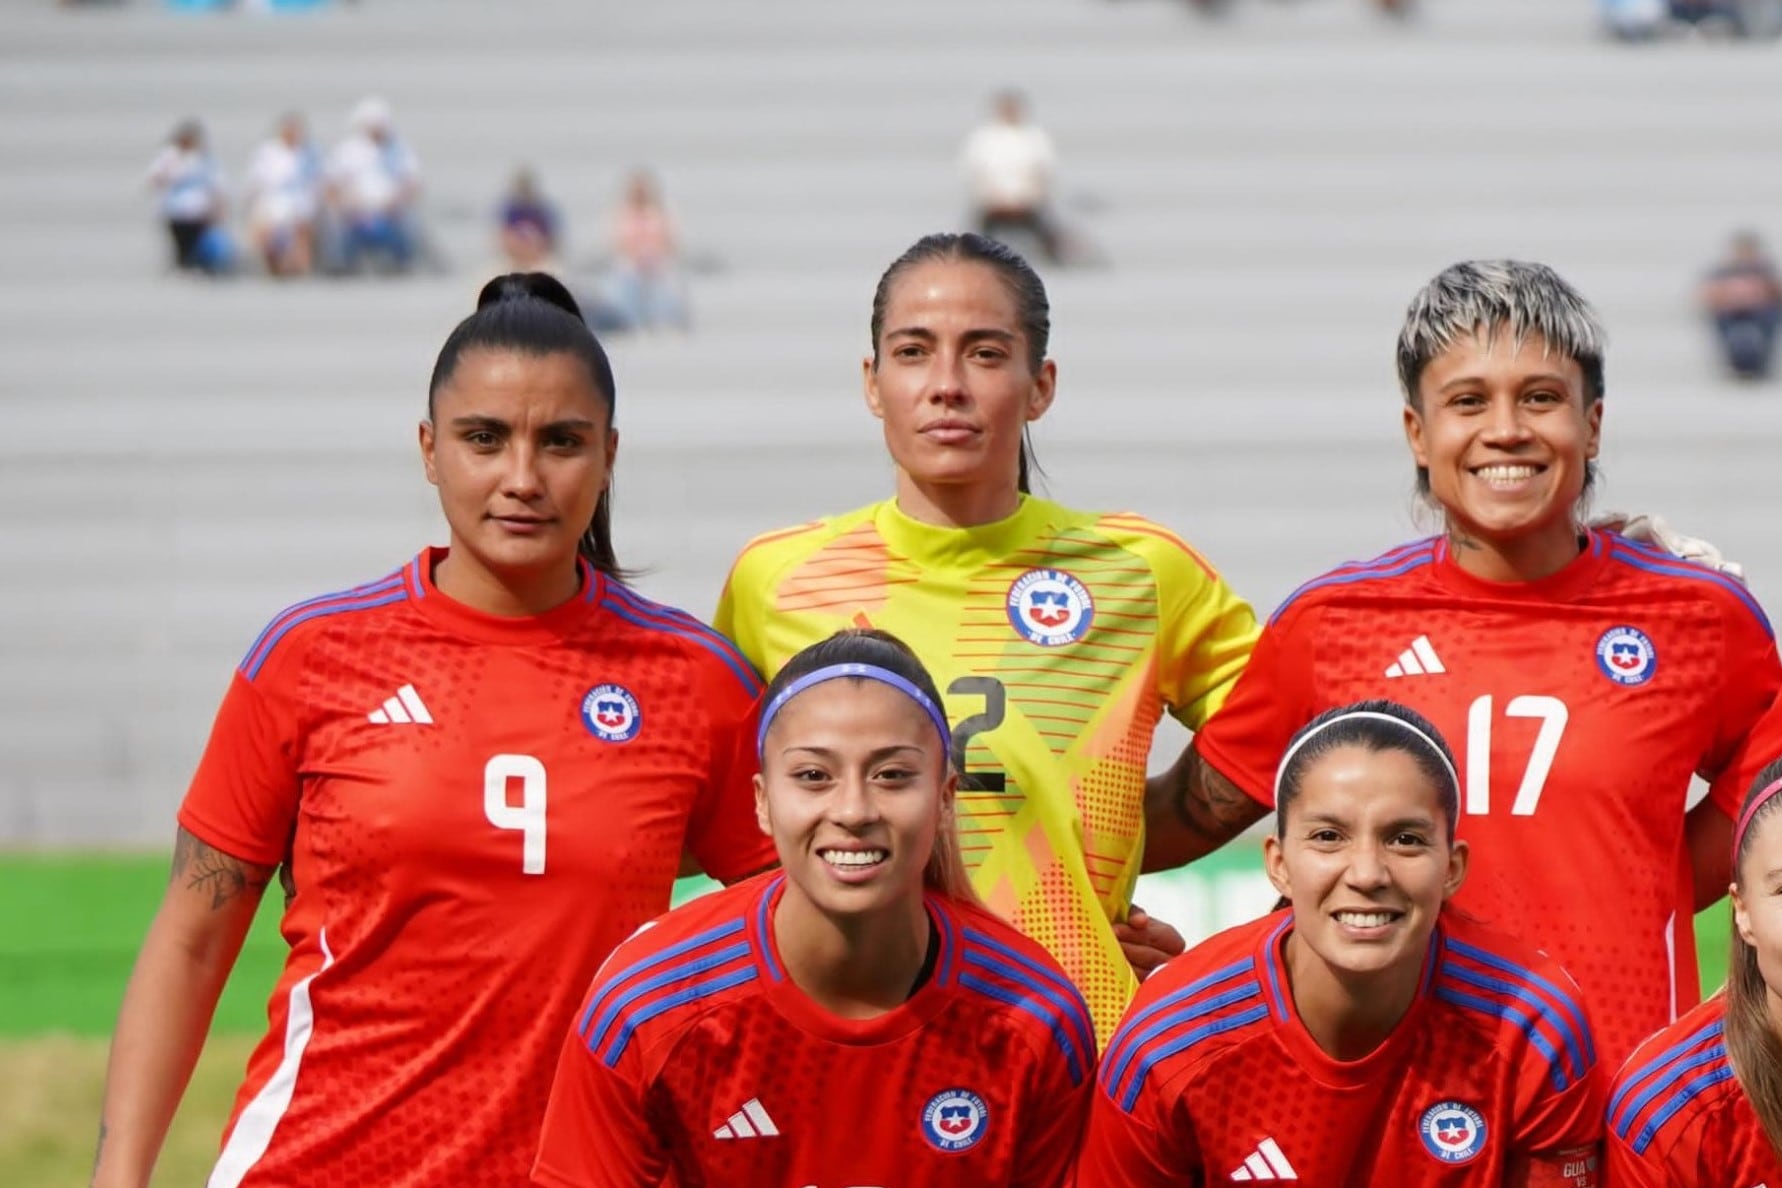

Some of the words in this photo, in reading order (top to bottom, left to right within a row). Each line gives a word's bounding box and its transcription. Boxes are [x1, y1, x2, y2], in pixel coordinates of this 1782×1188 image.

[484, 754, 546, 874] 9
[1466, 695, 1568, 815] 17
[1563, 1160, 1585, 1178] GUA
